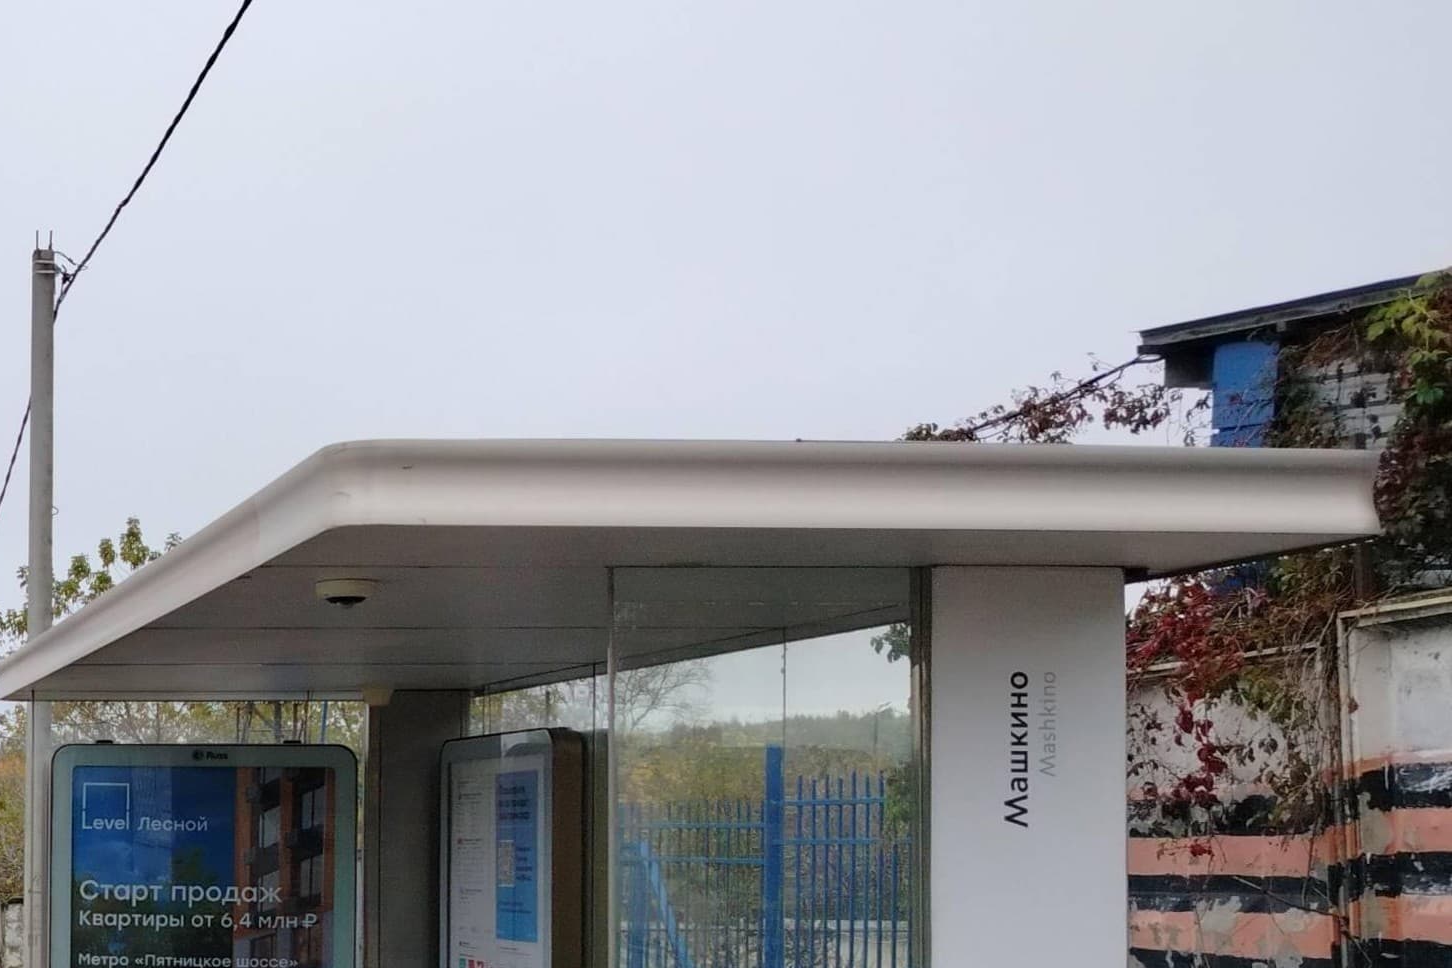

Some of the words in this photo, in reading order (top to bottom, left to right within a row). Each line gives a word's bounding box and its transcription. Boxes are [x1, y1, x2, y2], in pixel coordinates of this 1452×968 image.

[1038, 672, 1056, 777] Mashkino
[1004, 671, 1029, 828] Машкино
[82, 811, 129, 830] Level
[137, 815, 208, 831] Лесной
[79, 879, 163, 907] Старт
[171, 885, 282, 907] продаж
[79, 910, 185, 931] Квартиры
[191, 914, 215, 928] от
[221, 913, 252, 931] 6,4
[78, 953, 129, 968] Метро
[236, 957, 298, 968] шоссе»
